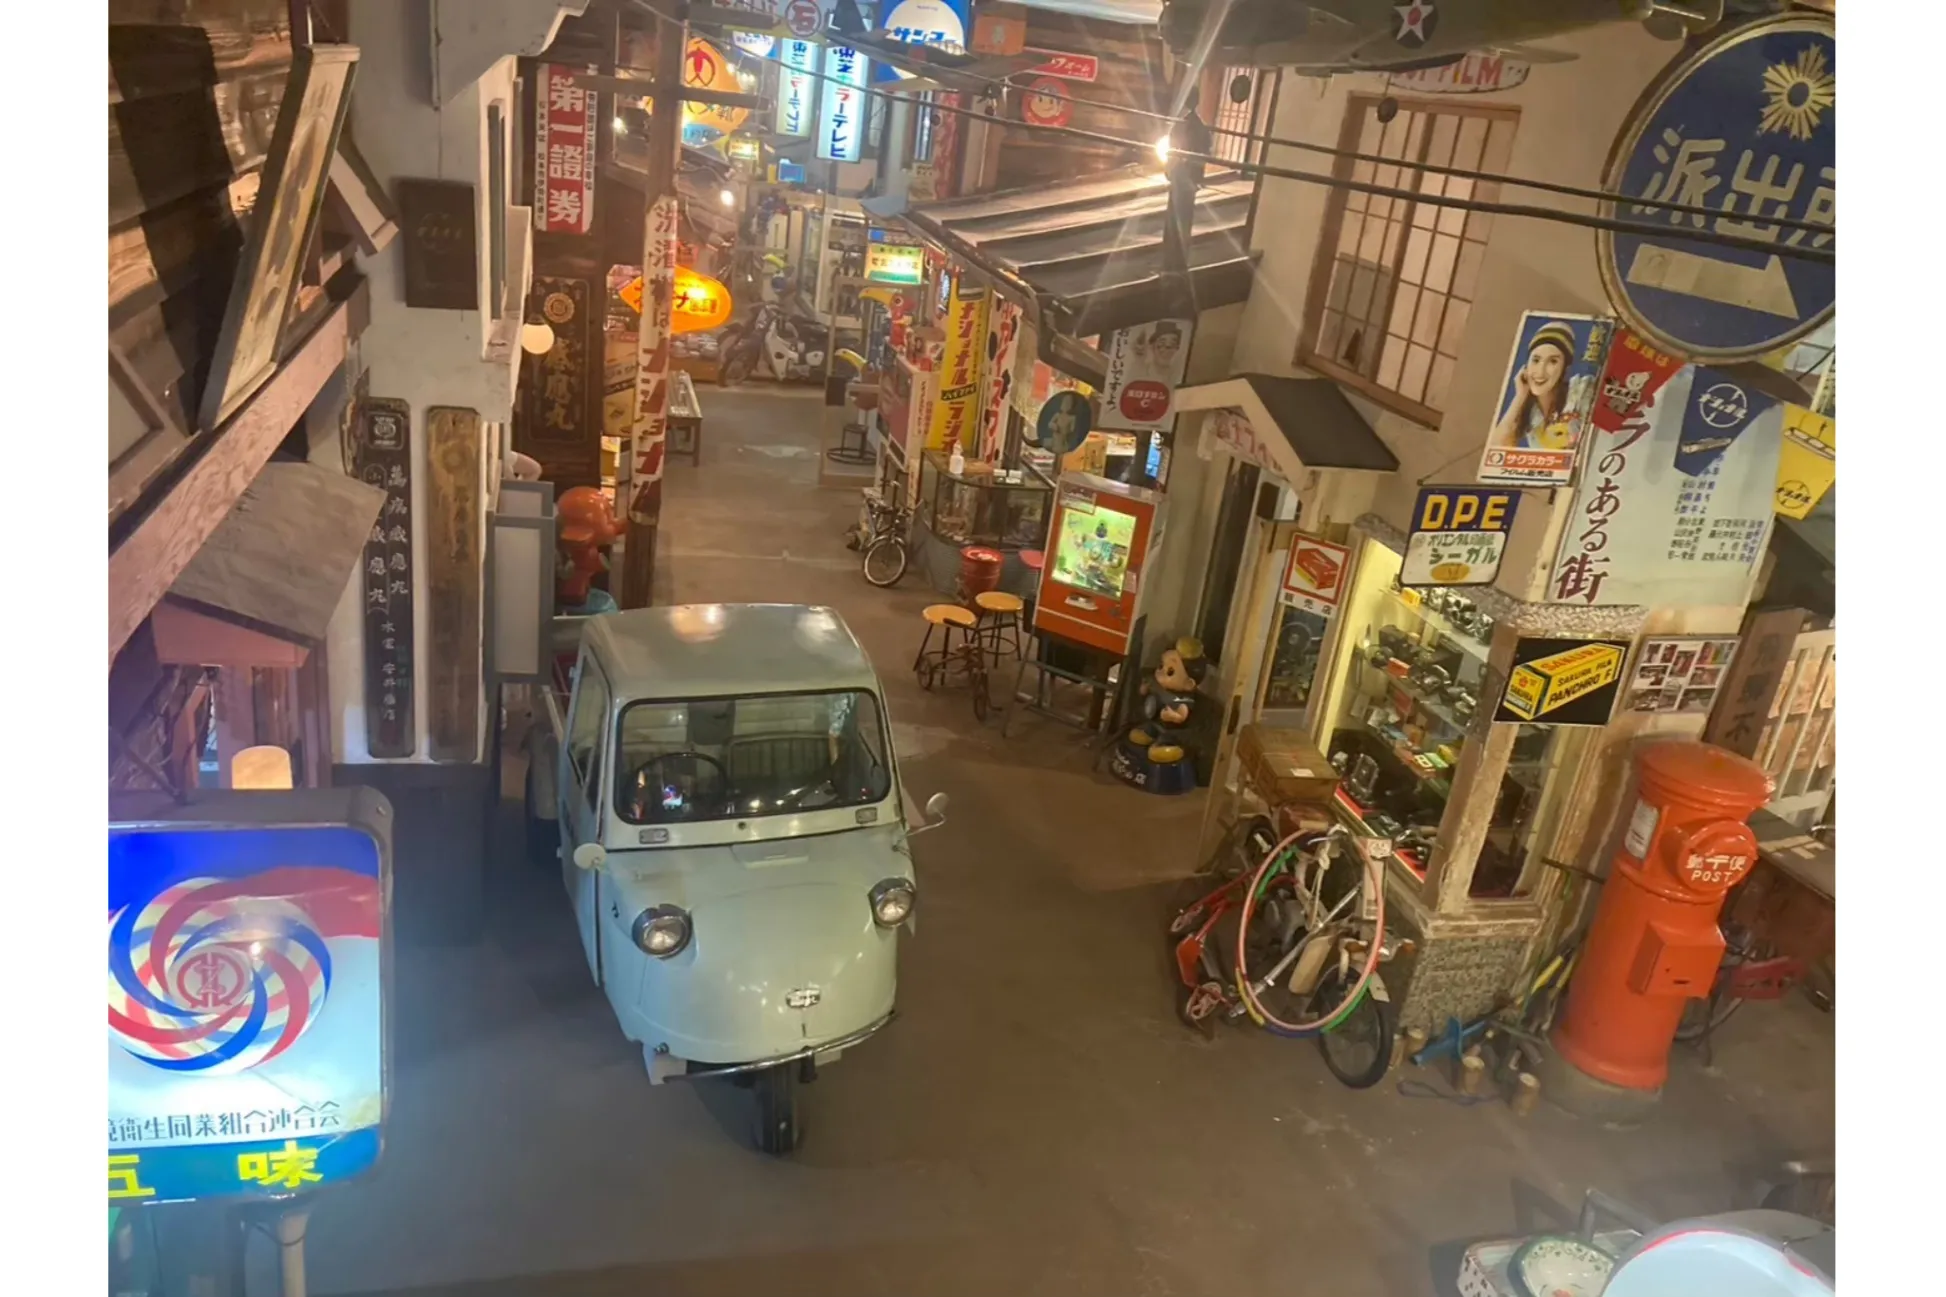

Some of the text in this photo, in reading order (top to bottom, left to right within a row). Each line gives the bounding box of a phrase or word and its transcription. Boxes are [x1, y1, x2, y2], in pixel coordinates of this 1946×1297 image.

[549, 75, 584, 224] 第一證券
[951, 302, 974, 385] ナショナル
[1699, 393, 1747, 419] ナショナル
[1505, 452, 1563, 466] サクラカラー
[1555, 396, 1655, 604] ラのある街
[1429, 547, 1498, 565] シーガル
[1548, 673, 1601, 706] PANCHRO
[1691, 870, 1733, 882] POST
